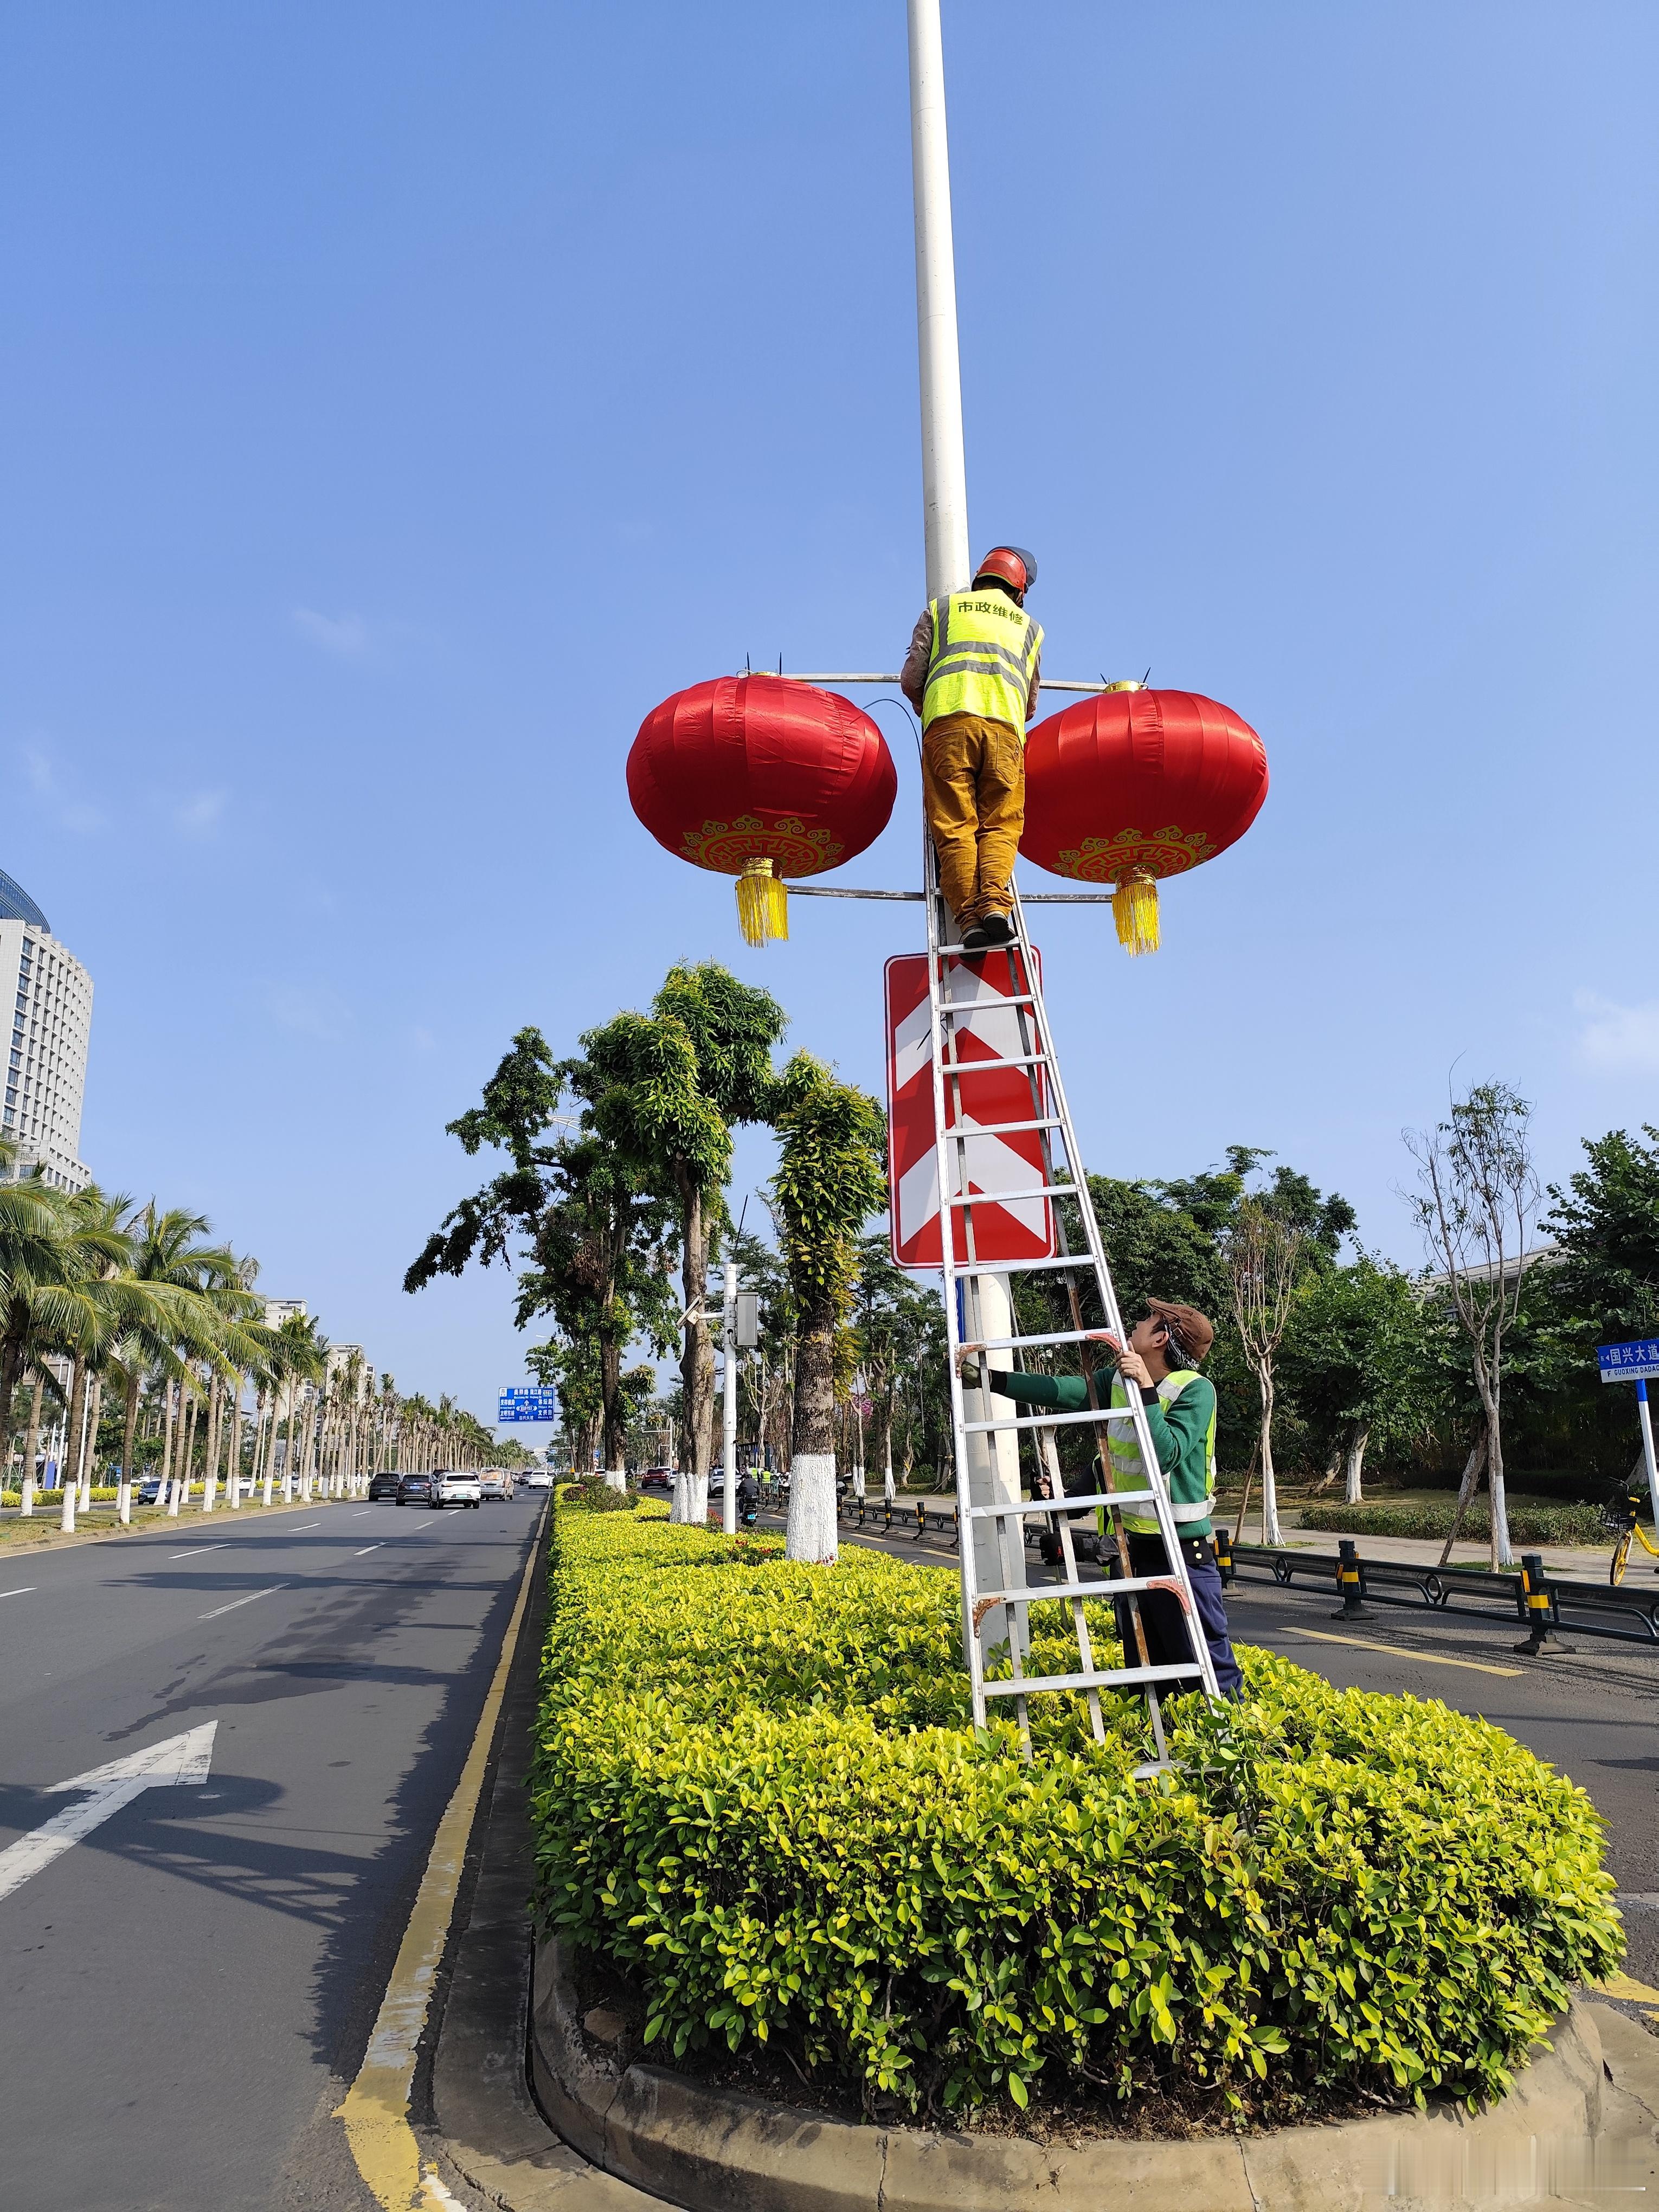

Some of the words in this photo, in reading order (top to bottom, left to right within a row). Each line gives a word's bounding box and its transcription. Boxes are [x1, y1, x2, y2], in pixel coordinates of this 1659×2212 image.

[957, 601, 1023, 625] 市政维修
[1610, 1344, 1657, 1365] 国兴大道
[1615, 1367, 1638, 1375] GUOXING
[1640, 1365, 1658, 1373] DADA
